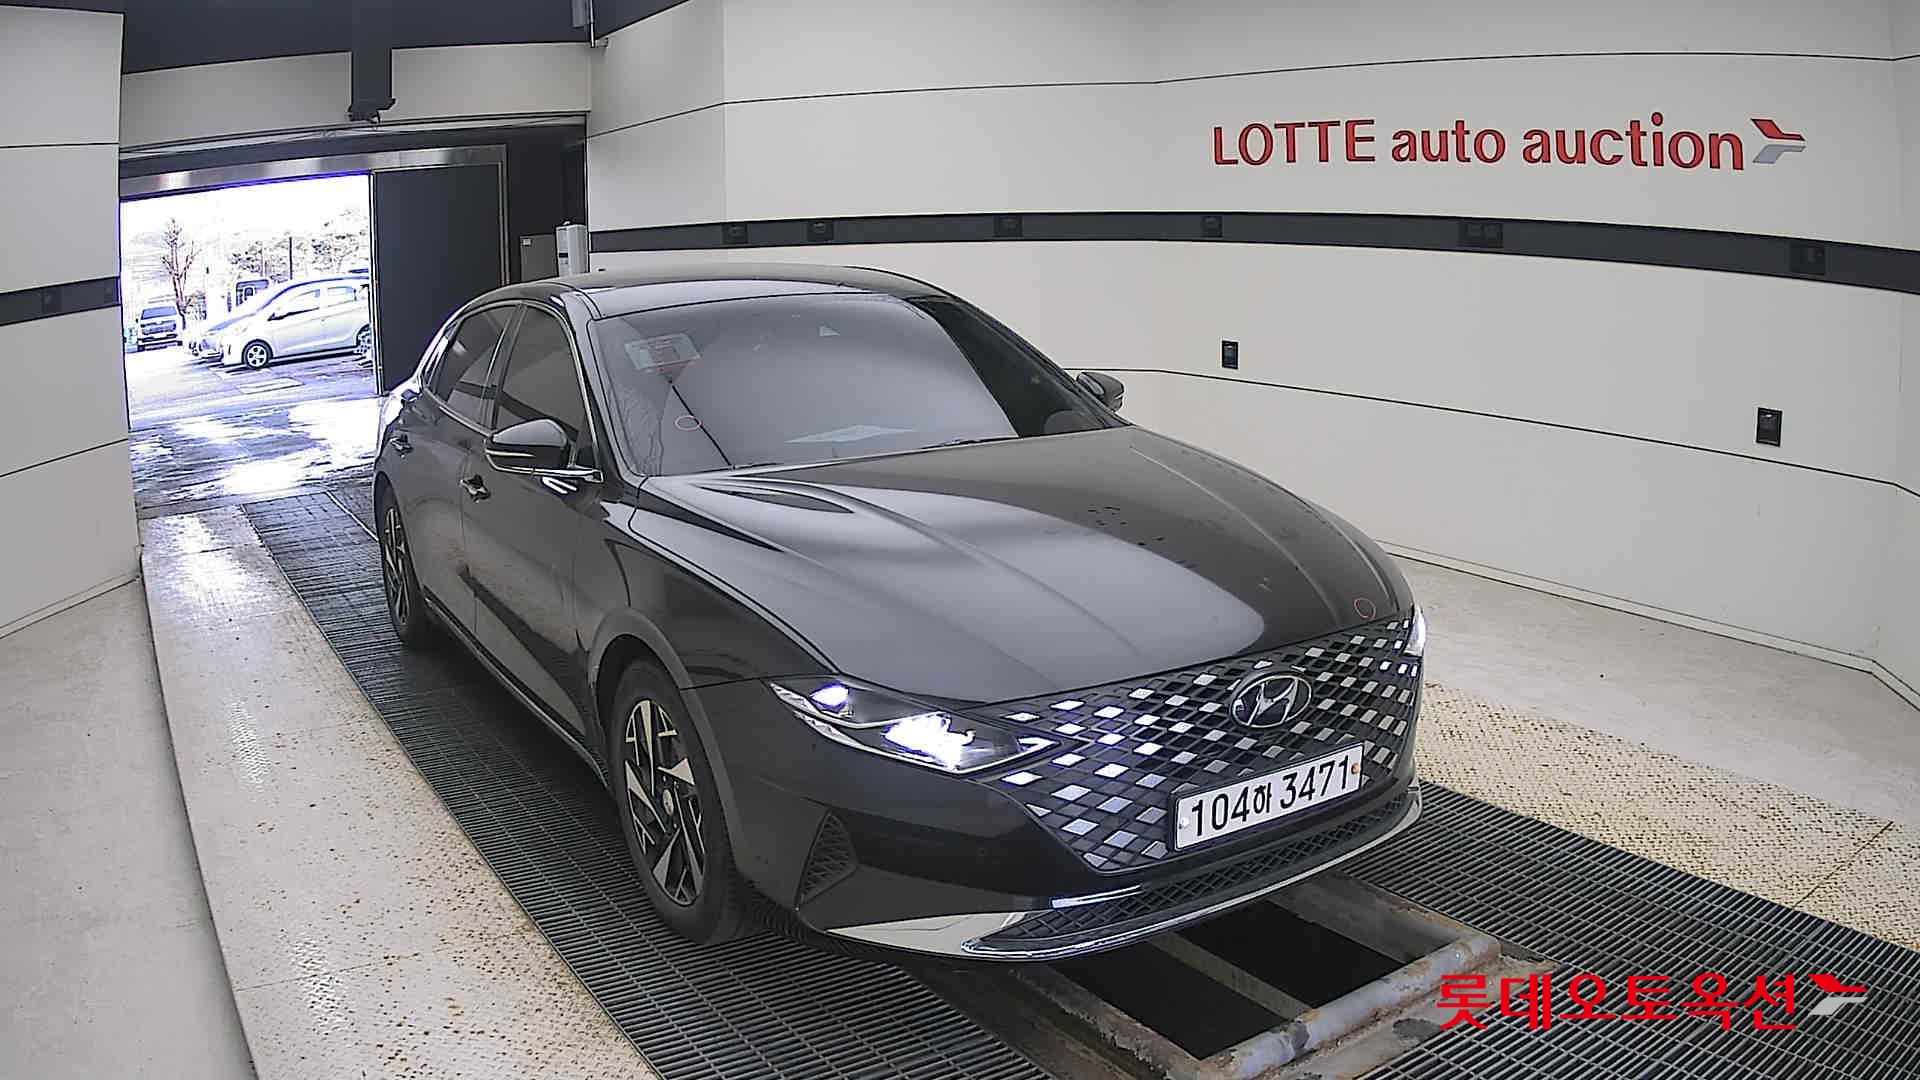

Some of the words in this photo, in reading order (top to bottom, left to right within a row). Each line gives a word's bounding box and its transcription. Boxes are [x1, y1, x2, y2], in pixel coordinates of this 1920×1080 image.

[1213, 119, 1376, 166] LOTTE
[1391, 119, 1506, 164] auto
[1521, 111, 1745, 171] auction
[1191, 782, 1272, 837] 104하
[1280, 755, 1350, 809] 3471
